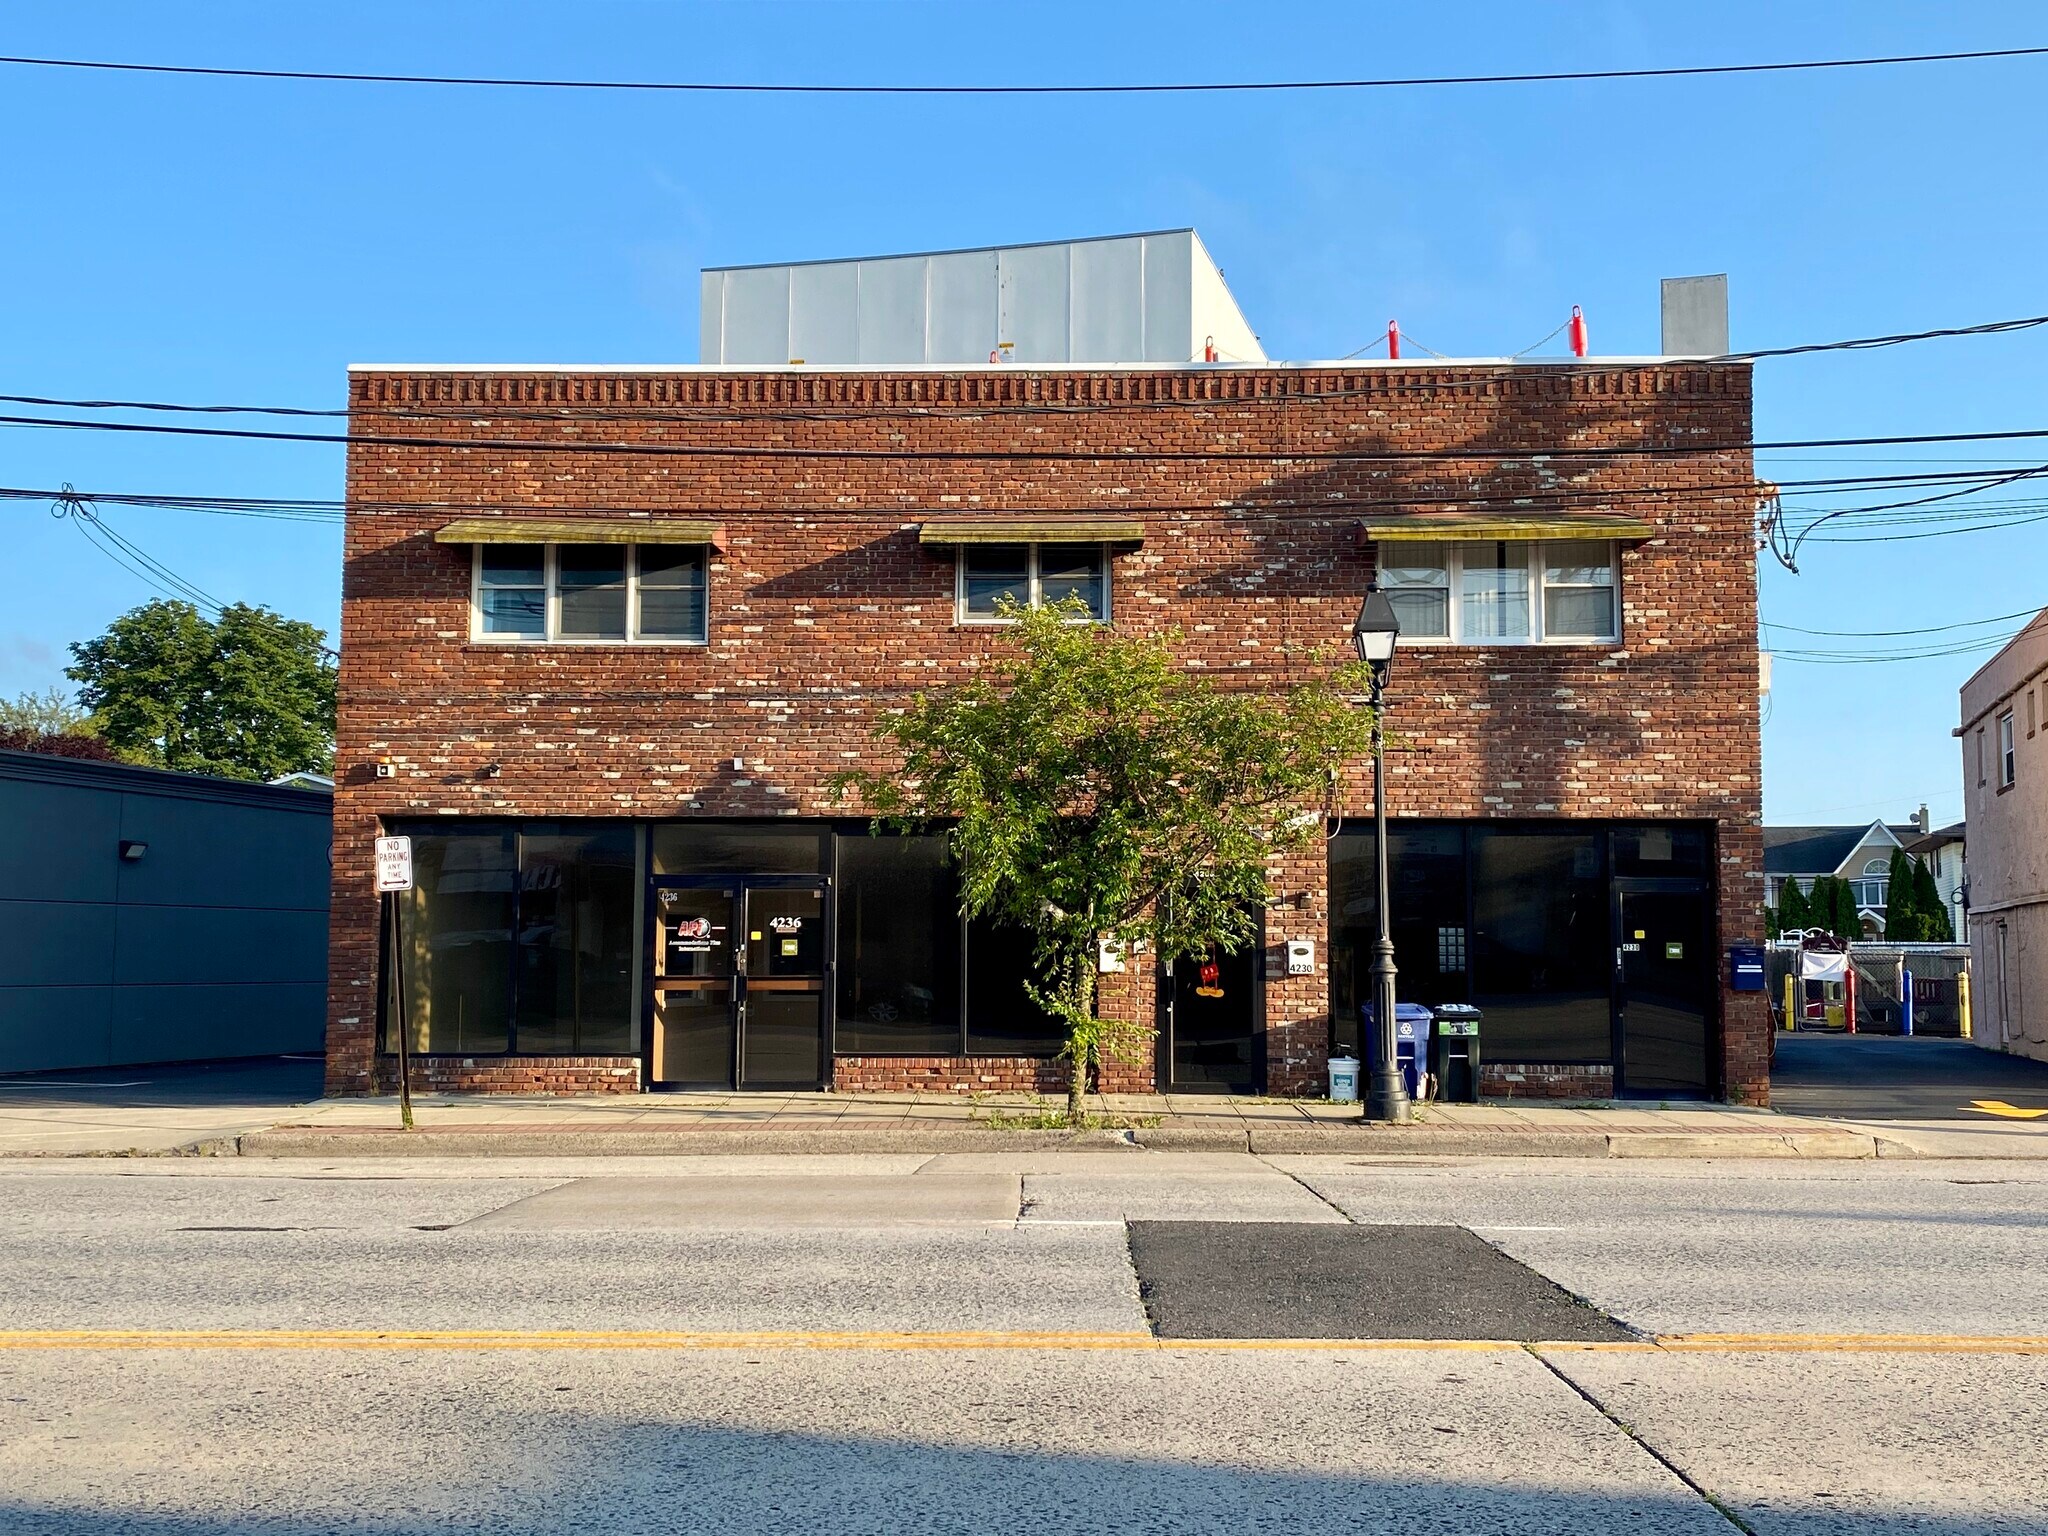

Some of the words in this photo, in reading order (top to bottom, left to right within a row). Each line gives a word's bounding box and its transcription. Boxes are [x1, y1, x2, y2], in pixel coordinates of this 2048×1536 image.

[386, 841, 400, 851] NO
[379, 851, 408, 862] PARKING
[387, 863, 401, 871] ANY
[387, 871, 402, 879] TIME
[660, 892, 678, 902] 4236
[769, 916, 802, 928] 4236
[1289, 963, 1313, 973] 4230
